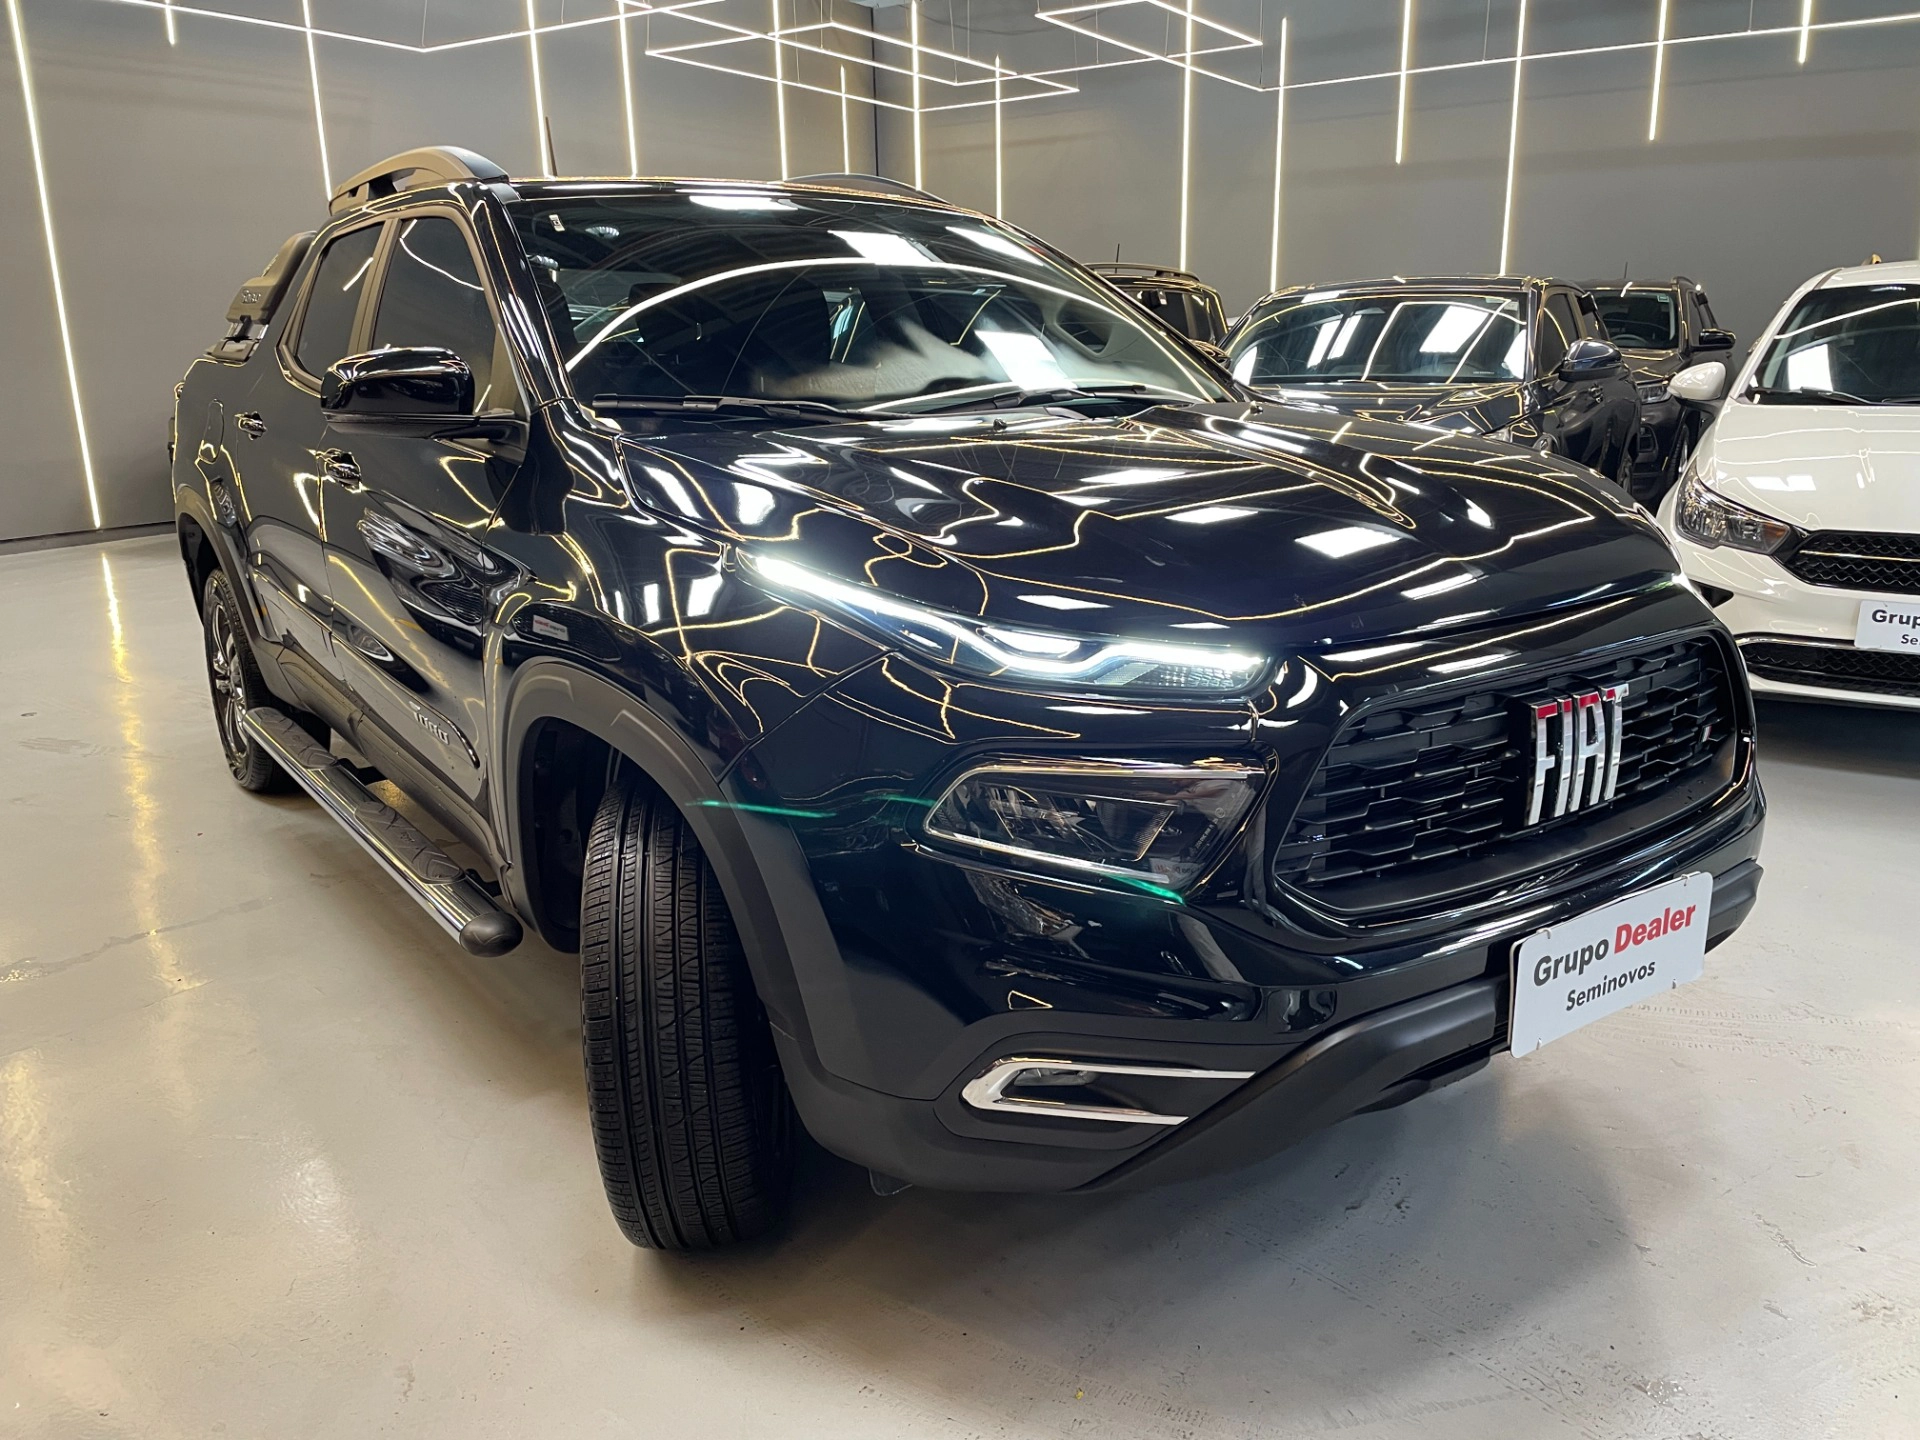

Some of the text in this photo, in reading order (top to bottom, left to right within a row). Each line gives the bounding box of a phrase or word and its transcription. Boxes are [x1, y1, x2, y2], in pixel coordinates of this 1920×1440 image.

[1900, 633, 1920, 646] Se
[408, 701, 449, 745] TORO
[1528, 683, 1629, 826] FIAT
[1533, 904, 1696, 987] Grupo Dealer
[1565, 960, 1656, 1011] Seminovos
